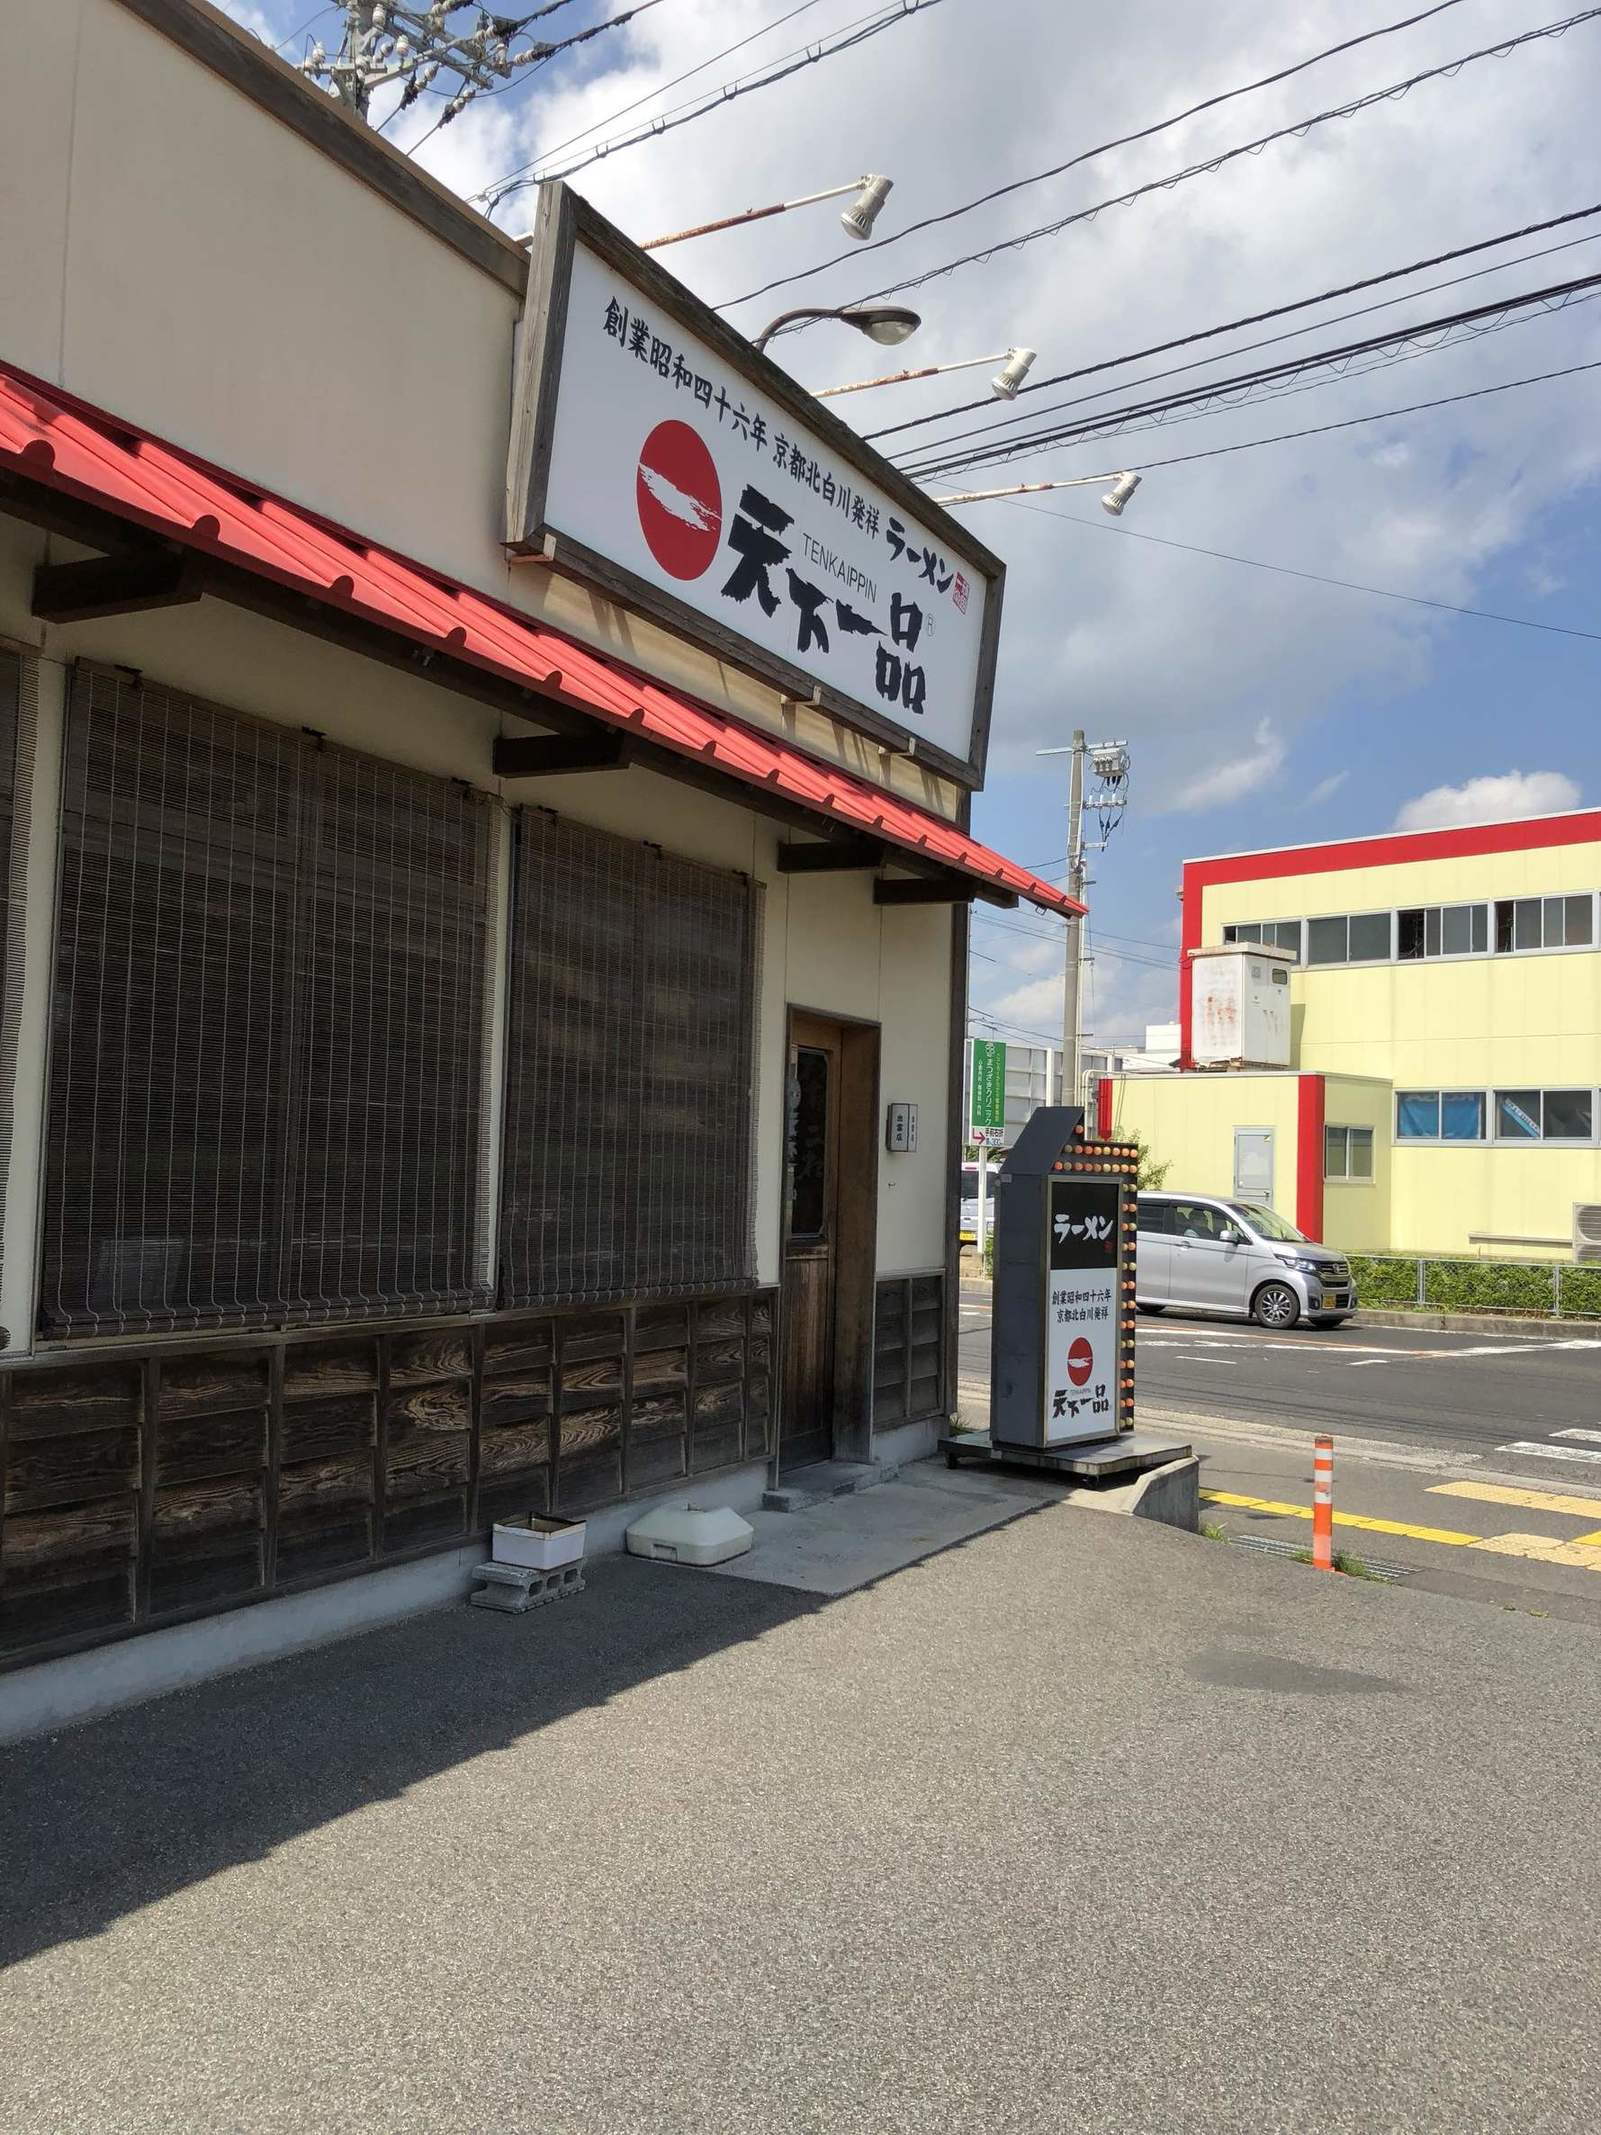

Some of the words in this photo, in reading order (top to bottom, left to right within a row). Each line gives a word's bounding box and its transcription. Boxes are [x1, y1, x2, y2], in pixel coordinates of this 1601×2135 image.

[603, 296, 768, 452] 創業昭和四十六年
[772, 433, 880, 539] 京都北白川発祥
[886, 516, 954, 593] ラーメン
[803, 532, 877, 603] TENKAIPPIN
[721, 484, 926, 715] 天下一品
[1053, 1213, 1114, 1245] ラーメン
[1052, 1288, 1112, 1306] 創業昭和四十六年
[1056, 1305, 1109, 1323] 京都北白川発祥
[1052, 1384, 1110, 1418] 天下一品
